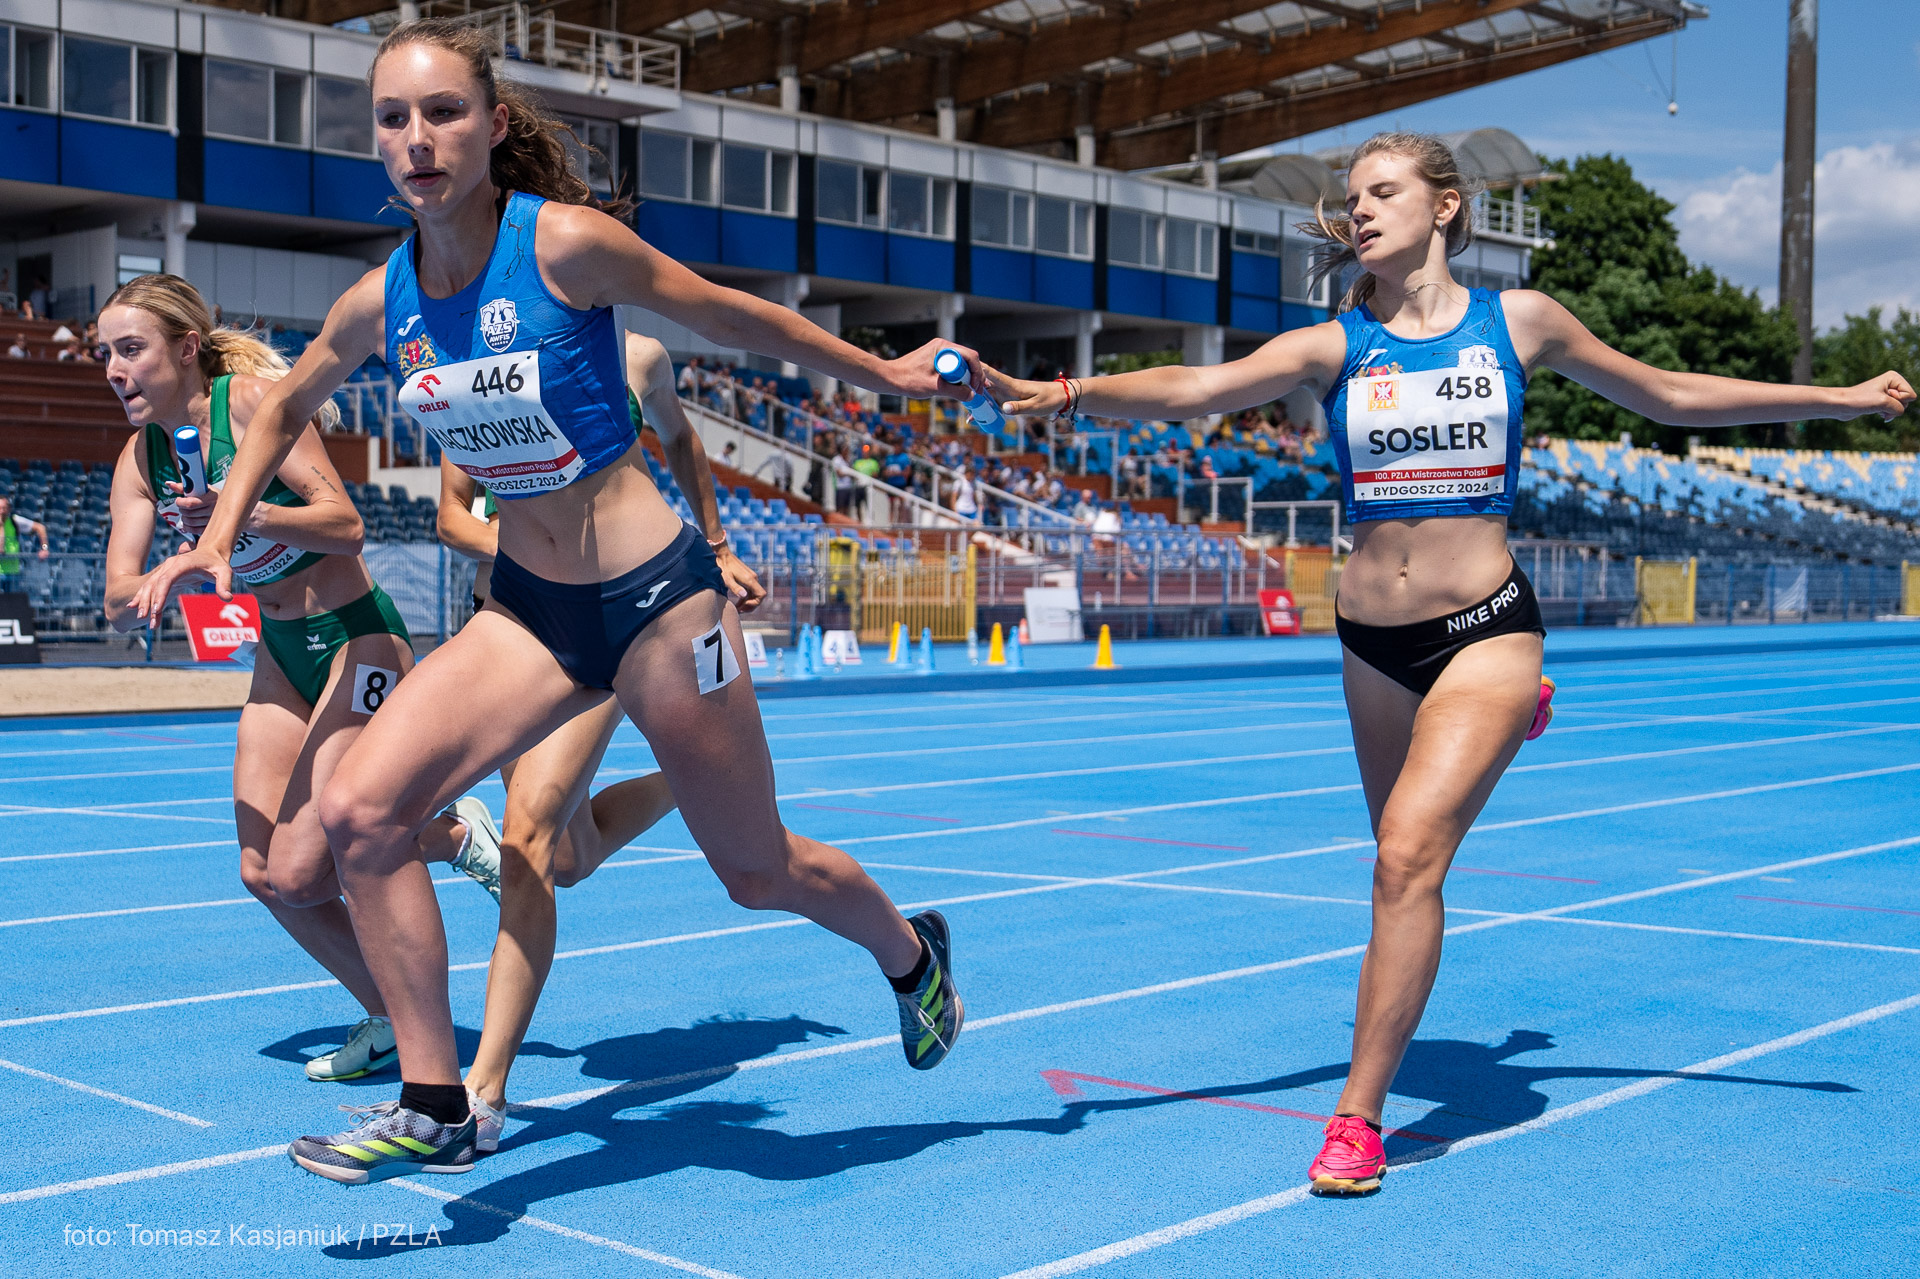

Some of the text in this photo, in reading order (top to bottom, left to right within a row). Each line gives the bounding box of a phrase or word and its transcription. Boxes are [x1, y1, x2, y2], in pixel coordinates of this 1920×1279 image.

[488, 322, 512, 337] AZS
[490, 334, 510, 343] AWFIS
[471, 363, 524, 398] 446
[1436, 376, 1492, 401] 458
[418, 400, 450, 414] ORLEN
[1369, 400, 1397, 410] PZLA
[427, 415, 557, 453] KACZKOWSKA
[1369, 422, 1488, 455] SOSLER
[492, 465, 535, 476] Mistrzostwa
[535, 461, 557, 471] Polski
[1374, 468, 1488, 480] 100. PZLA Mistrzostwa Polski
[482, 474, 567, 491] DGOSZCZ 2024
[1374, 482, 1489, 497] BYDGOSZCZ 2024
[269, 553, 293, 572] 2024
[1447, 582, 1519, 633] NIKE PRO
[209, 632, 252, 642] ORLEN
[307, 643, 327, 651] erima
[704, 628, 724, 684] 7
[363, 671, 387, 712] 8
